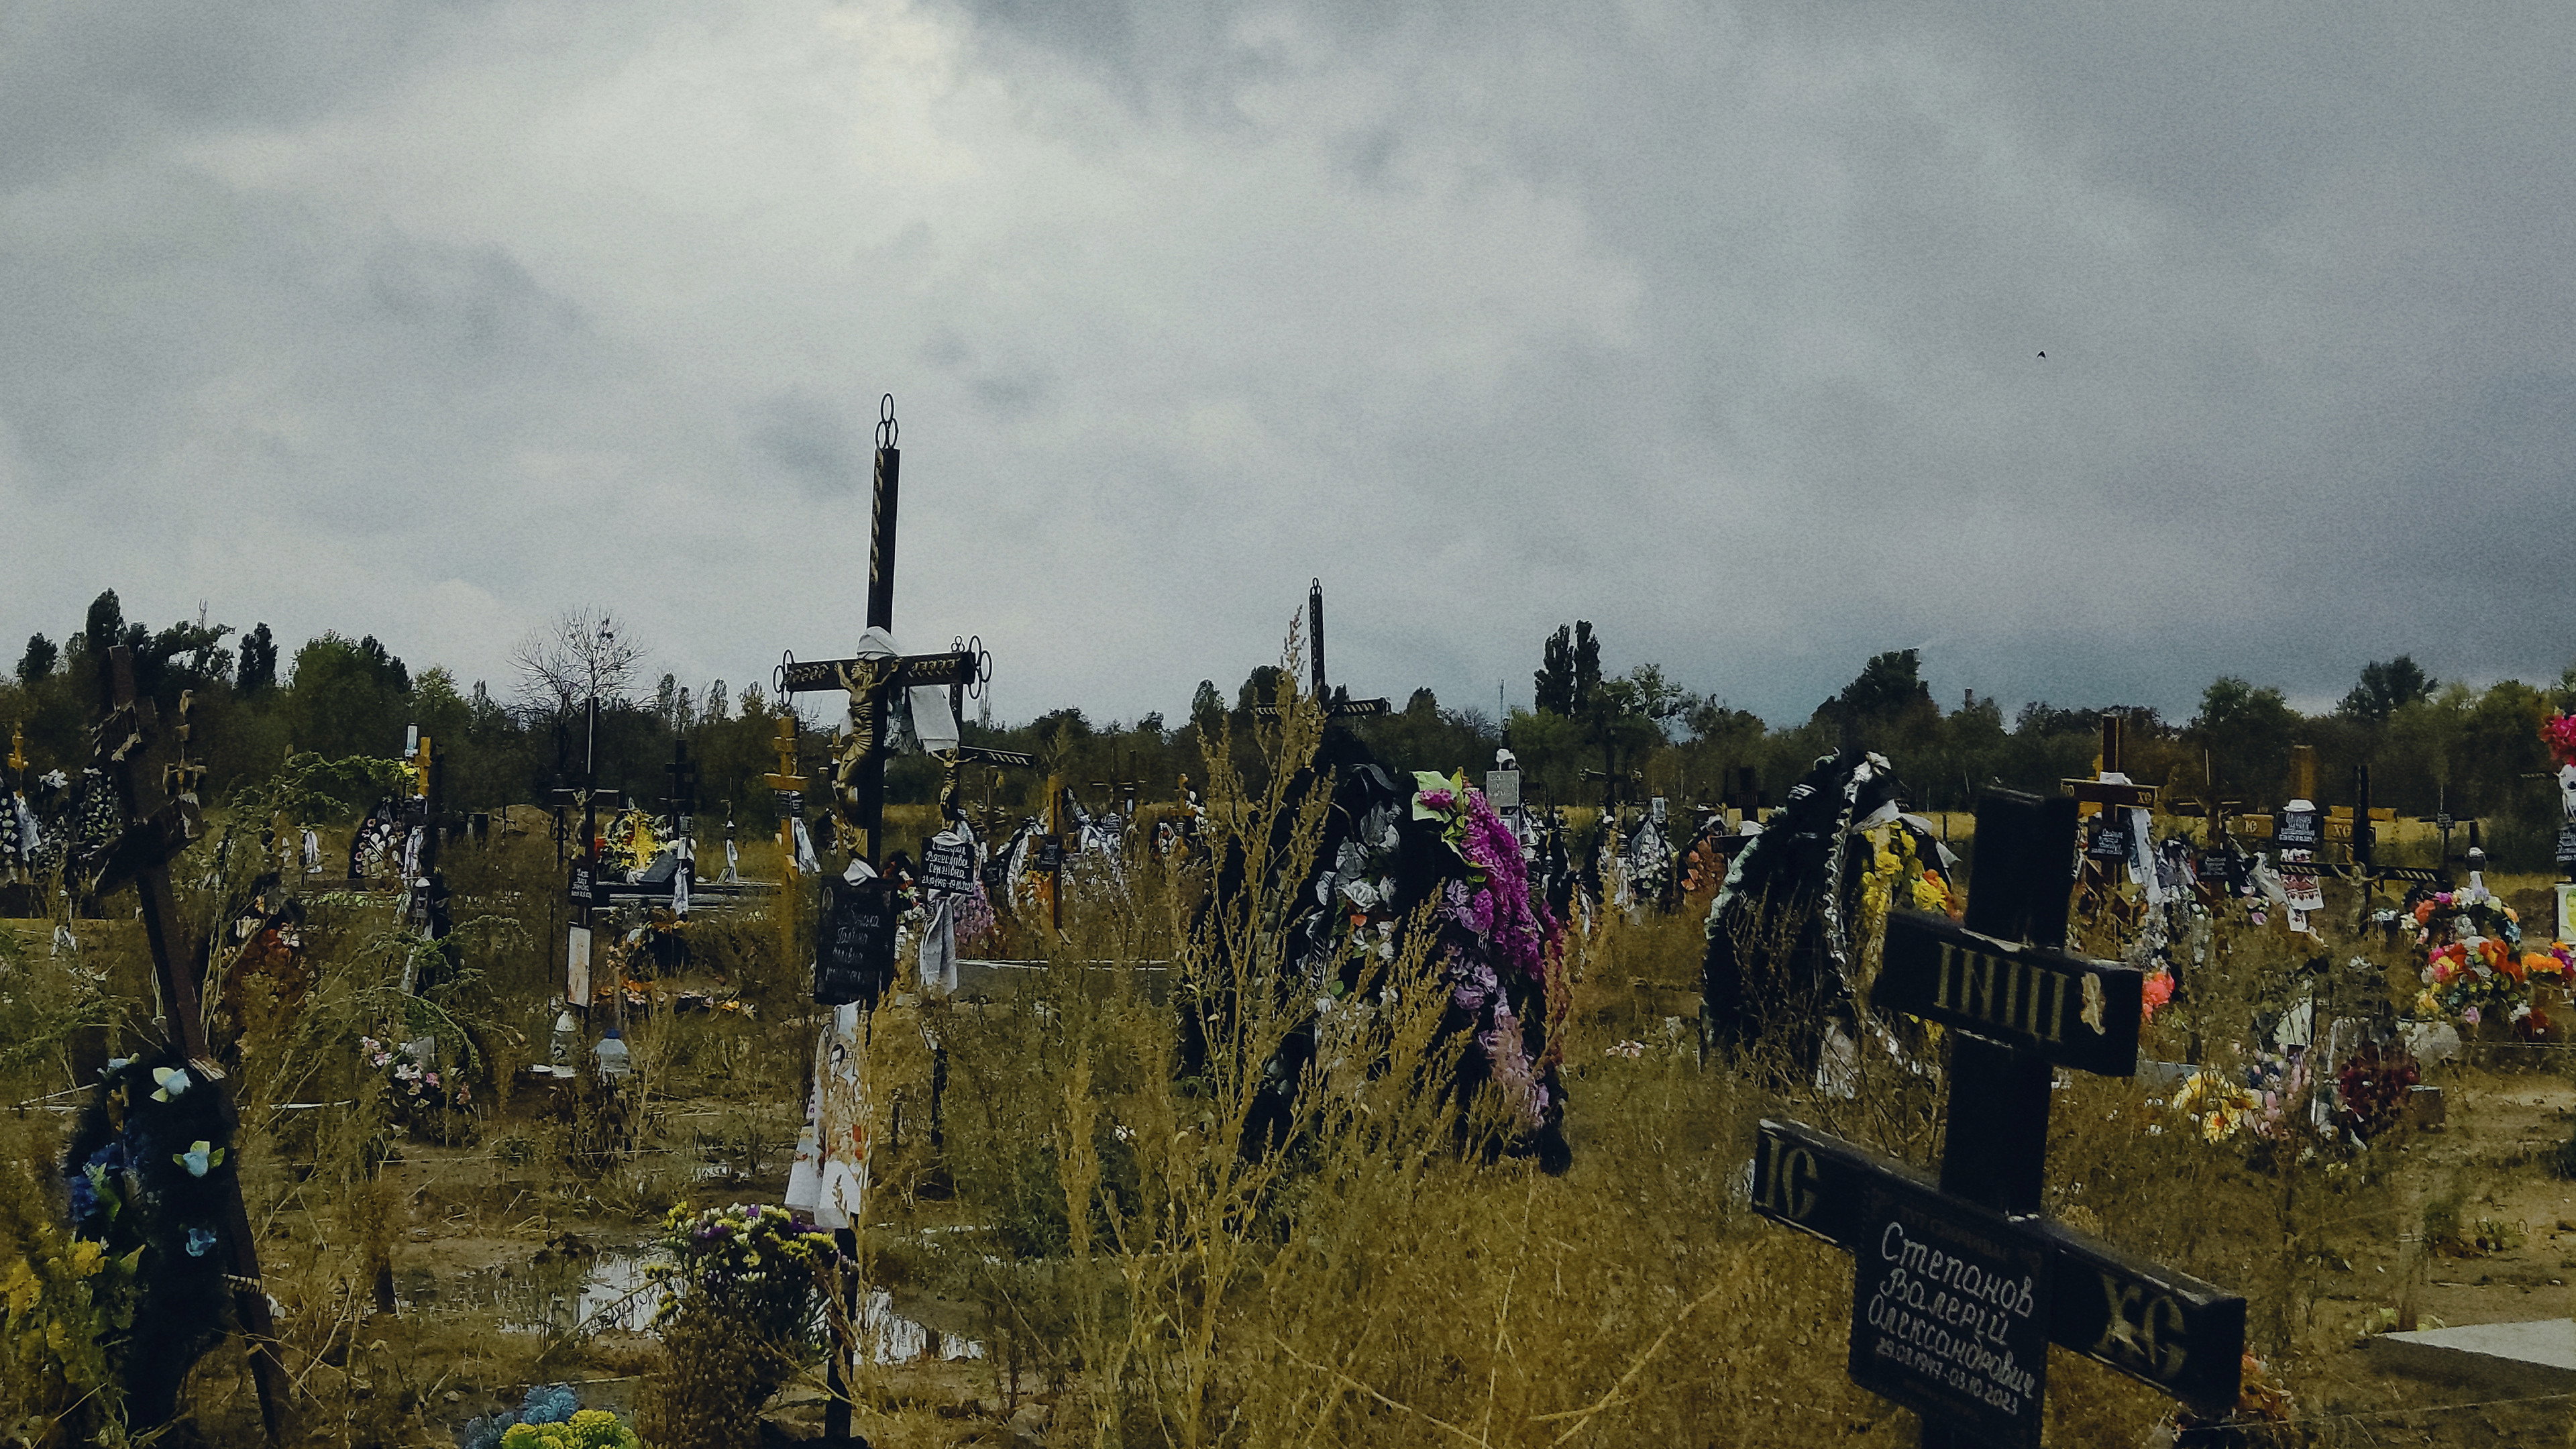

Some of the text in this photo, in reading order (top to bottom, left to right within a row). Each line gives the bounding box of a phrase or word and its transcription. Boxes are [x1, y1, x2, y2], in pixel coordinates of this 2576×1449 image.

[1880, 1268, 2008, 1346] Валерій
[1882, 1222, 2033, 1318] Степанов
[1868, 1293, 2035, 1399] Олександрович
